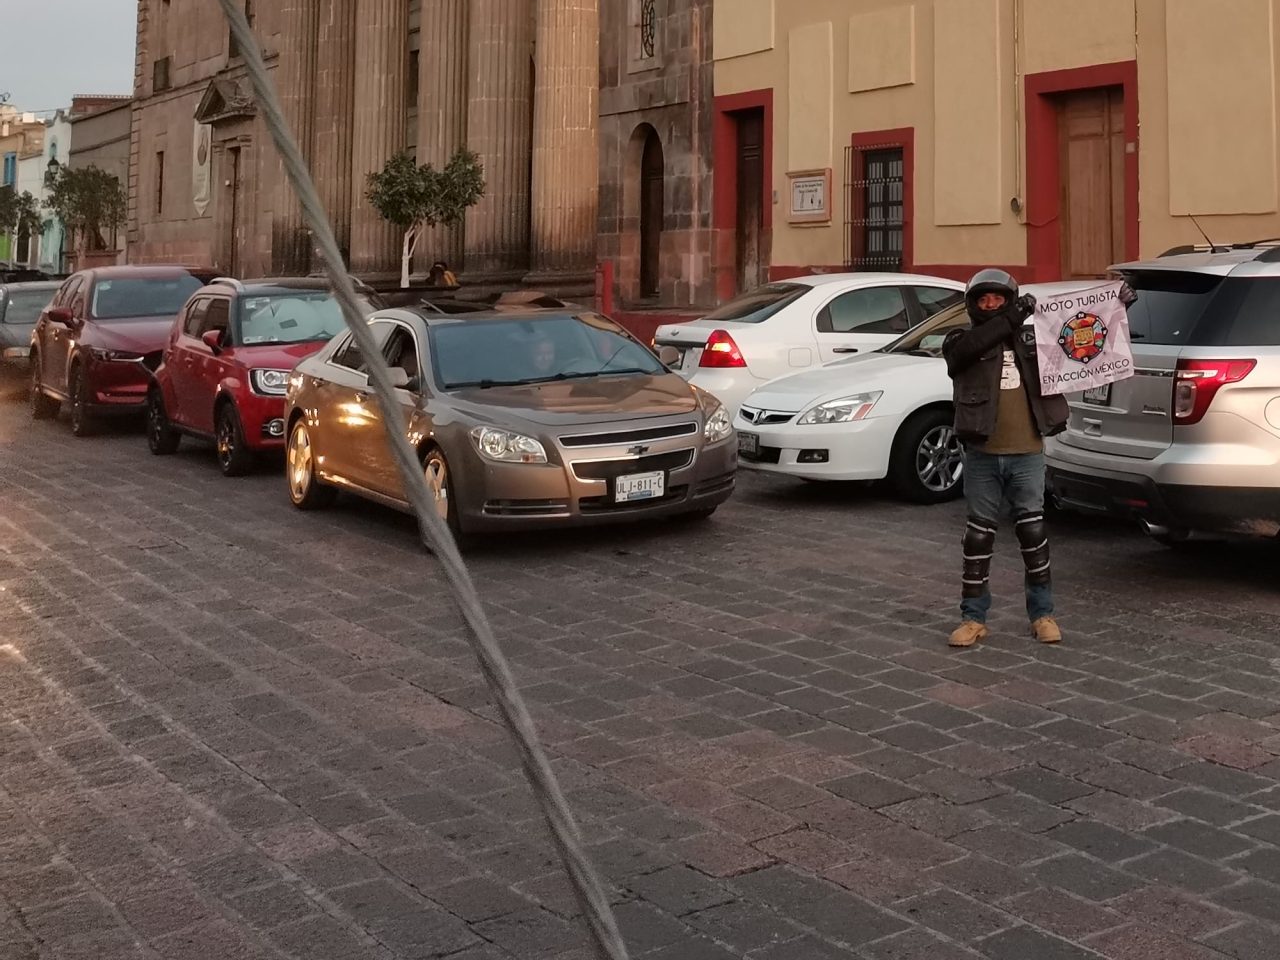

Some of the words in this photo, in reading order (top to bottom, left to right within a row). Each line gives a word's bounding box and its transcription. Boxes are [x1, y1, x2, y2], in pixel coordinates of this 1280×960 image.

[1040, 300, 1074, 313] MOTO
[1076, 290, 1118, 306] TURISTA
[1043, 375, 1055, 385] EN
[1056, 367, 1094, 383] ACCIÓN
[1094, 359, 1130, 375] MÉXICO
